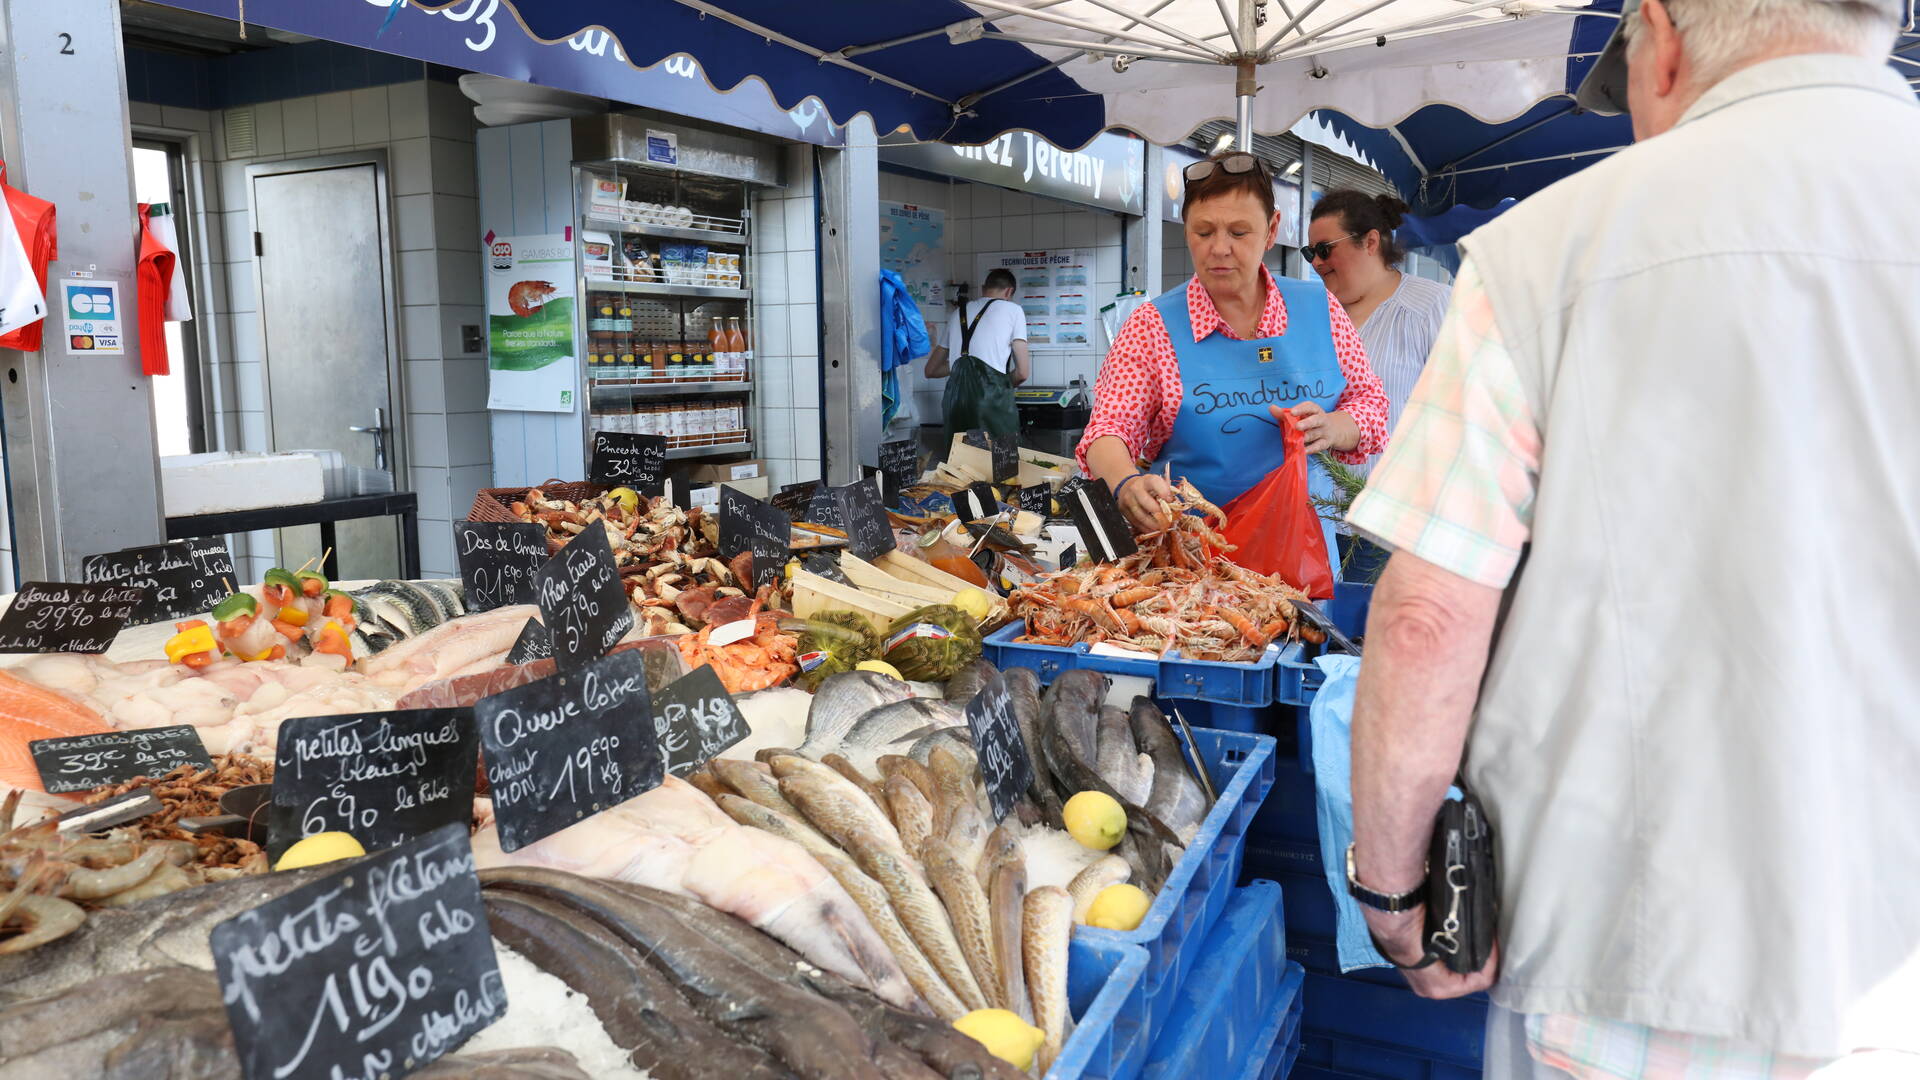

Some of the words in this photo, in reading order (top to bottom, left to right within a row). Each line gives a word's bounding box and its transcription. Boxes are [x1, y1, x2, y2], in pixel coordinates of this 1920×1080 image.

[59, 33, 75, 56] 2
[1002, 258, 1039, 266] TECHNIQUES
[1040, 257, 1048, 265] DE
[1049, 255, 1070, 264] PÊCHE
[1192, 379, 1335, 415] Sandrine
[462, 529, 493, 556] Dos
[495, 533, 511, 551] de
[494, 701, 580, 748] Queue
